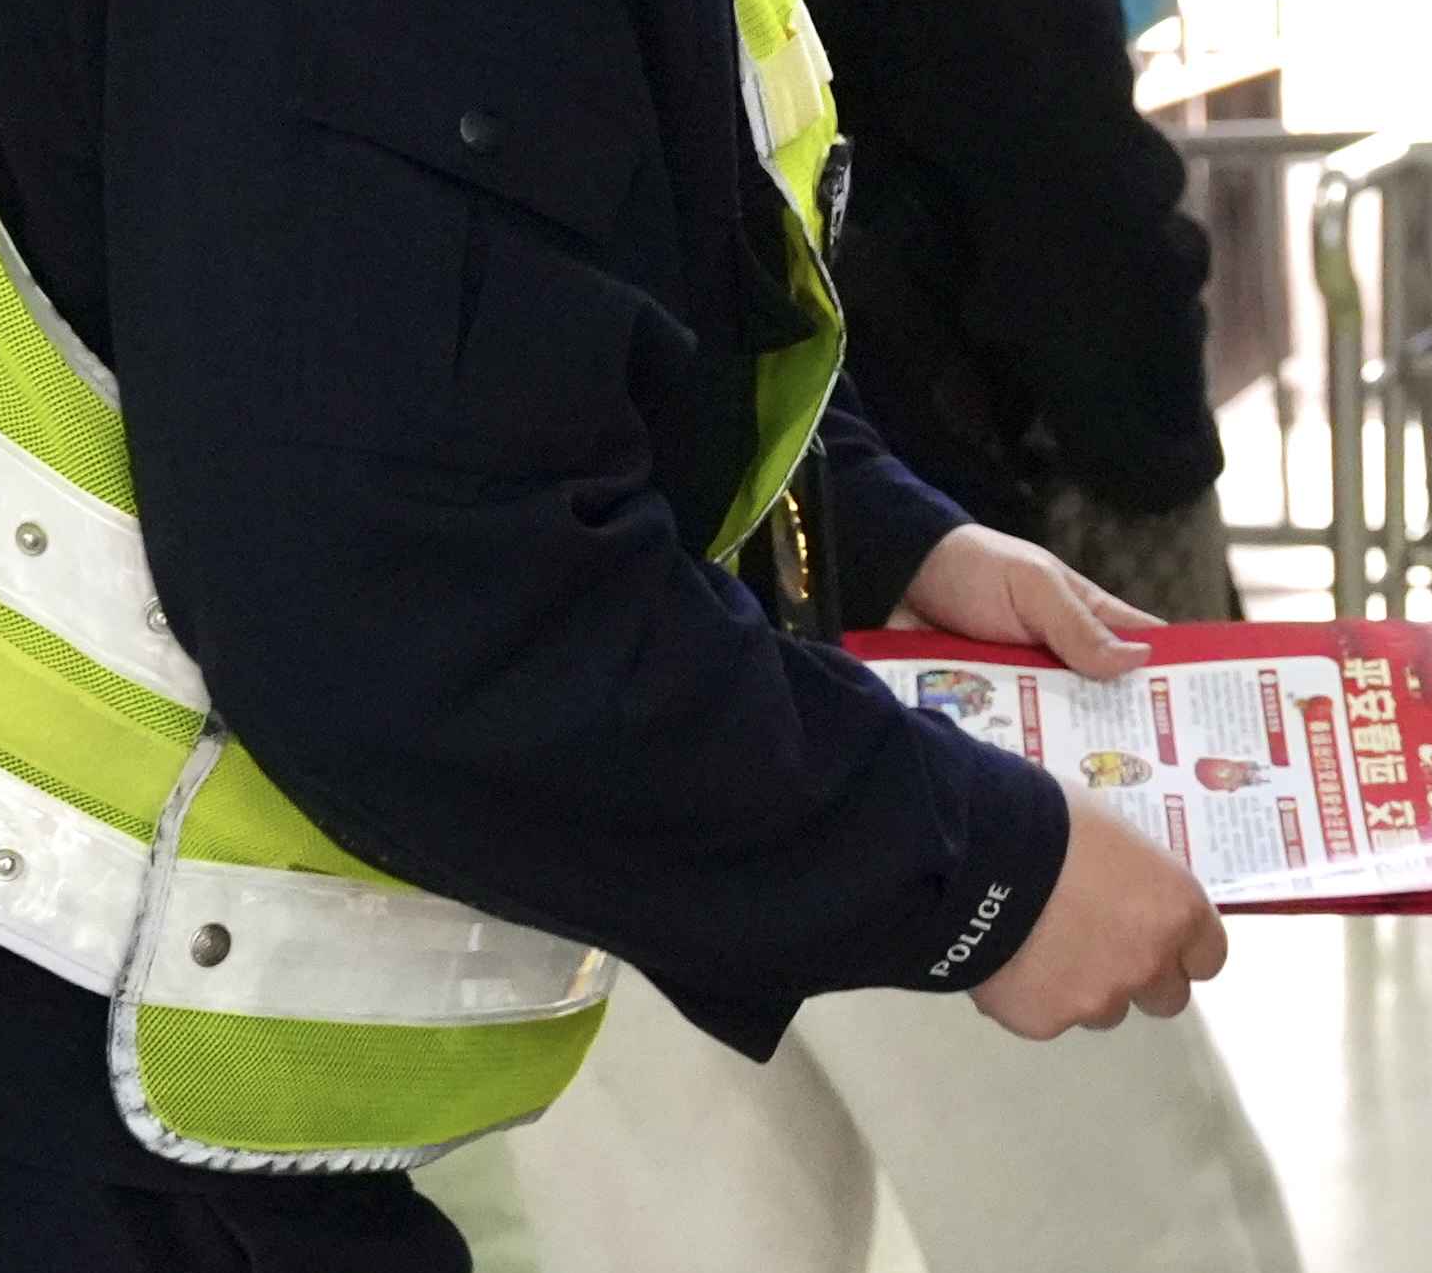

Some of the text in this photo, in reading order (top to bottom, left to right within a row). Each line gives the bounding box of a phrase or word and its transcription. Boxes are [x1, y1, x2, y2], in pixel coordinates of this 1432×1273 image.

[1343, 657, 1409, 785] 平安春运
[929, 882, 1013, 977] POLICE
